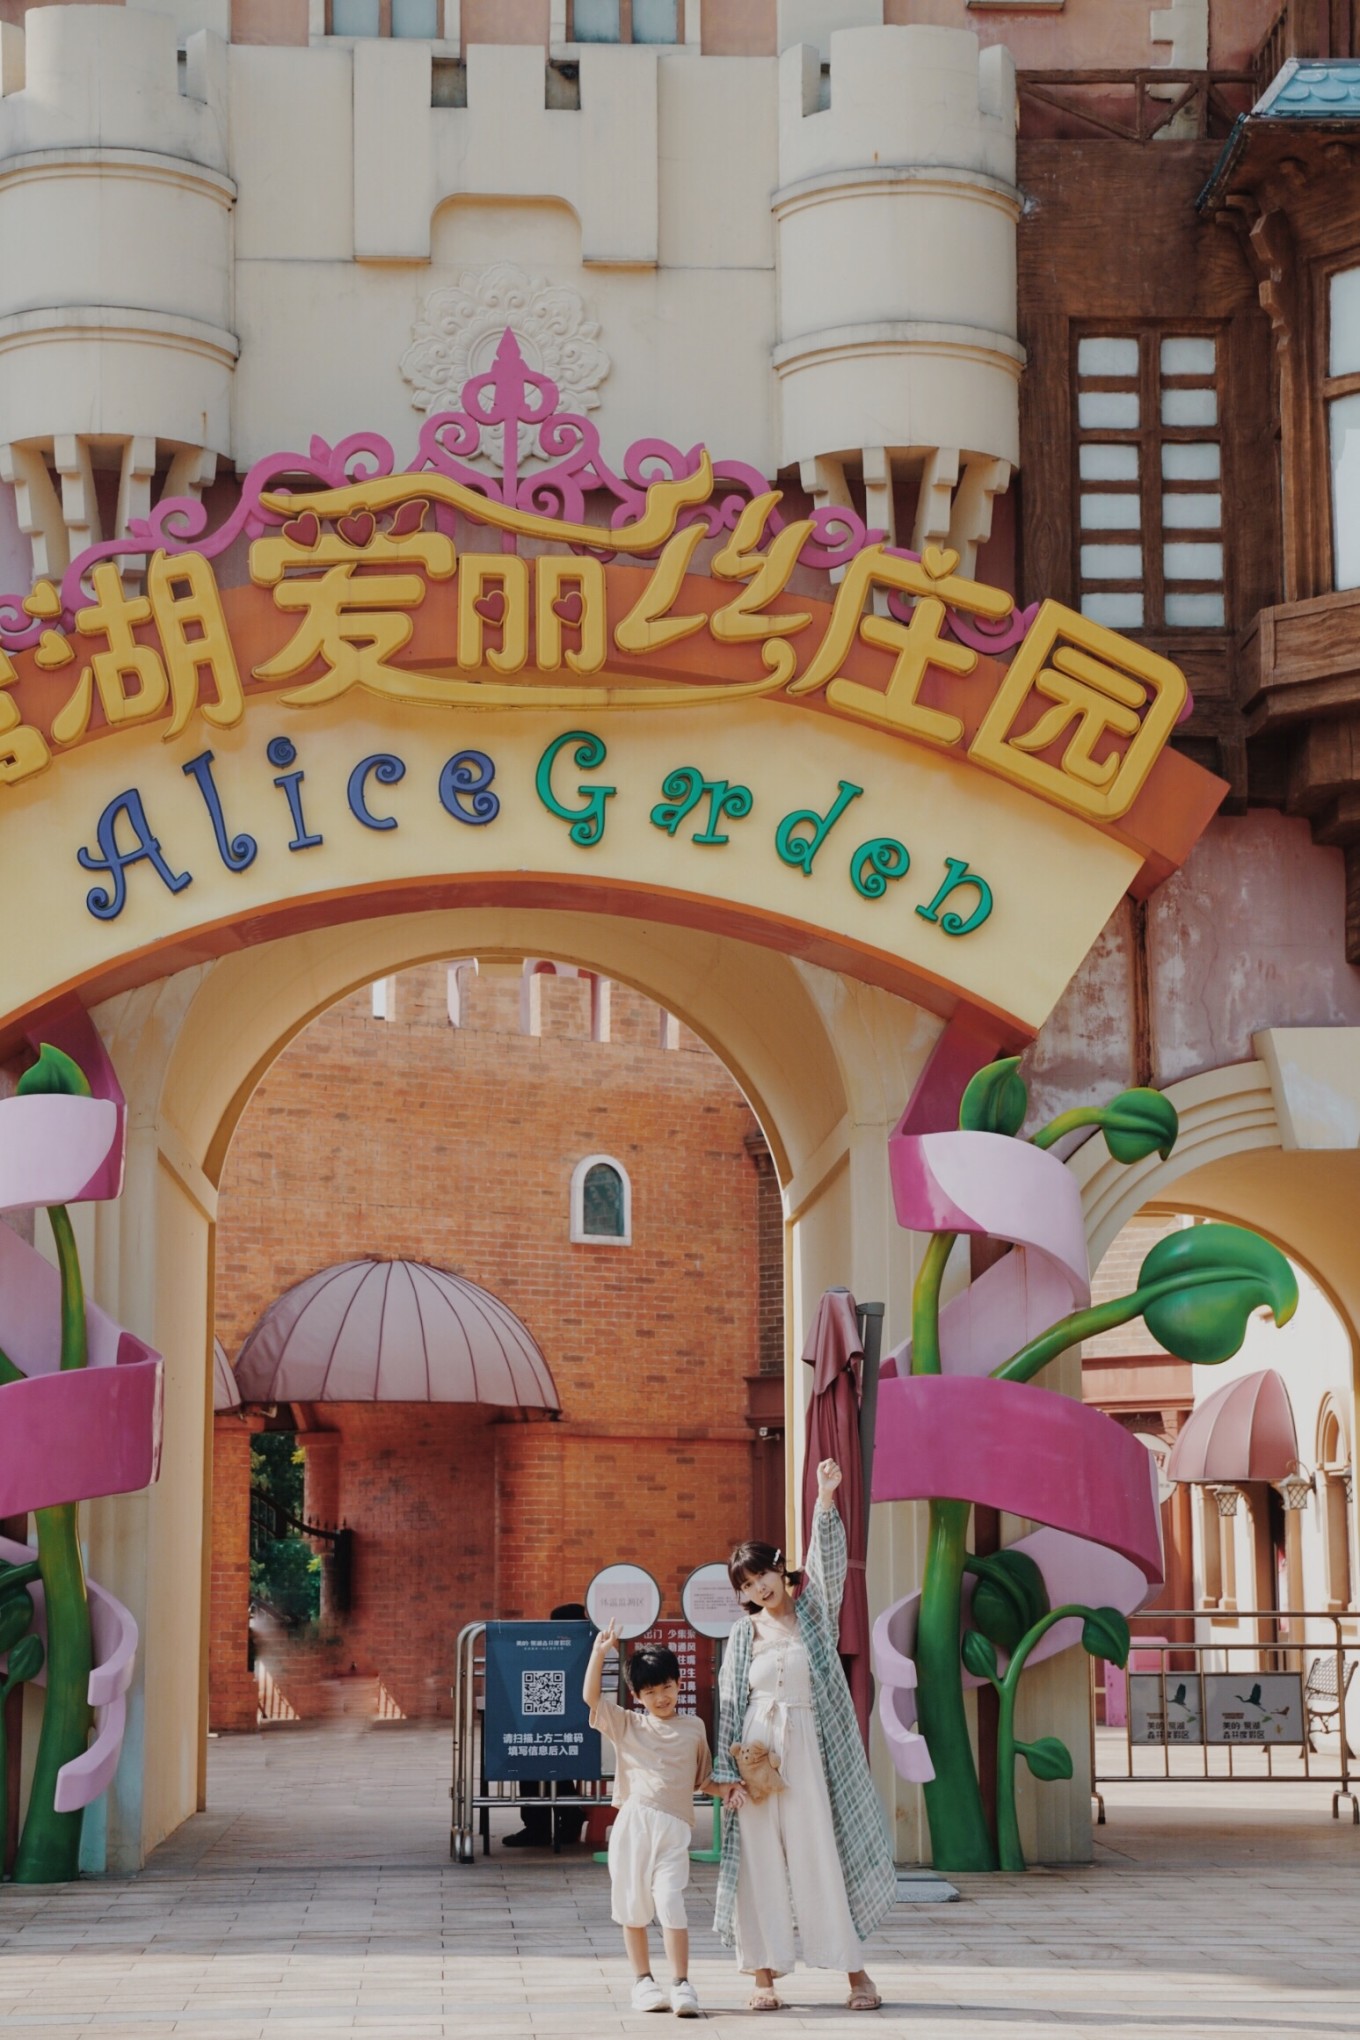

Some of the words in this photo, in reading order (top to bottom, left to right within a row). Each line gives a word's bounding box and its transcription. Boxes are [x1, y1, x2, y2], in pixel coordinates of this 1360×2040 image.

[77, 736, 501, 921] Alice
[535, 730, 994, 937] Garden
[503, 1732, 584, 1744] 请扫描上方二维码
[508, 1745, 579, 1757] 填写信息后入园
